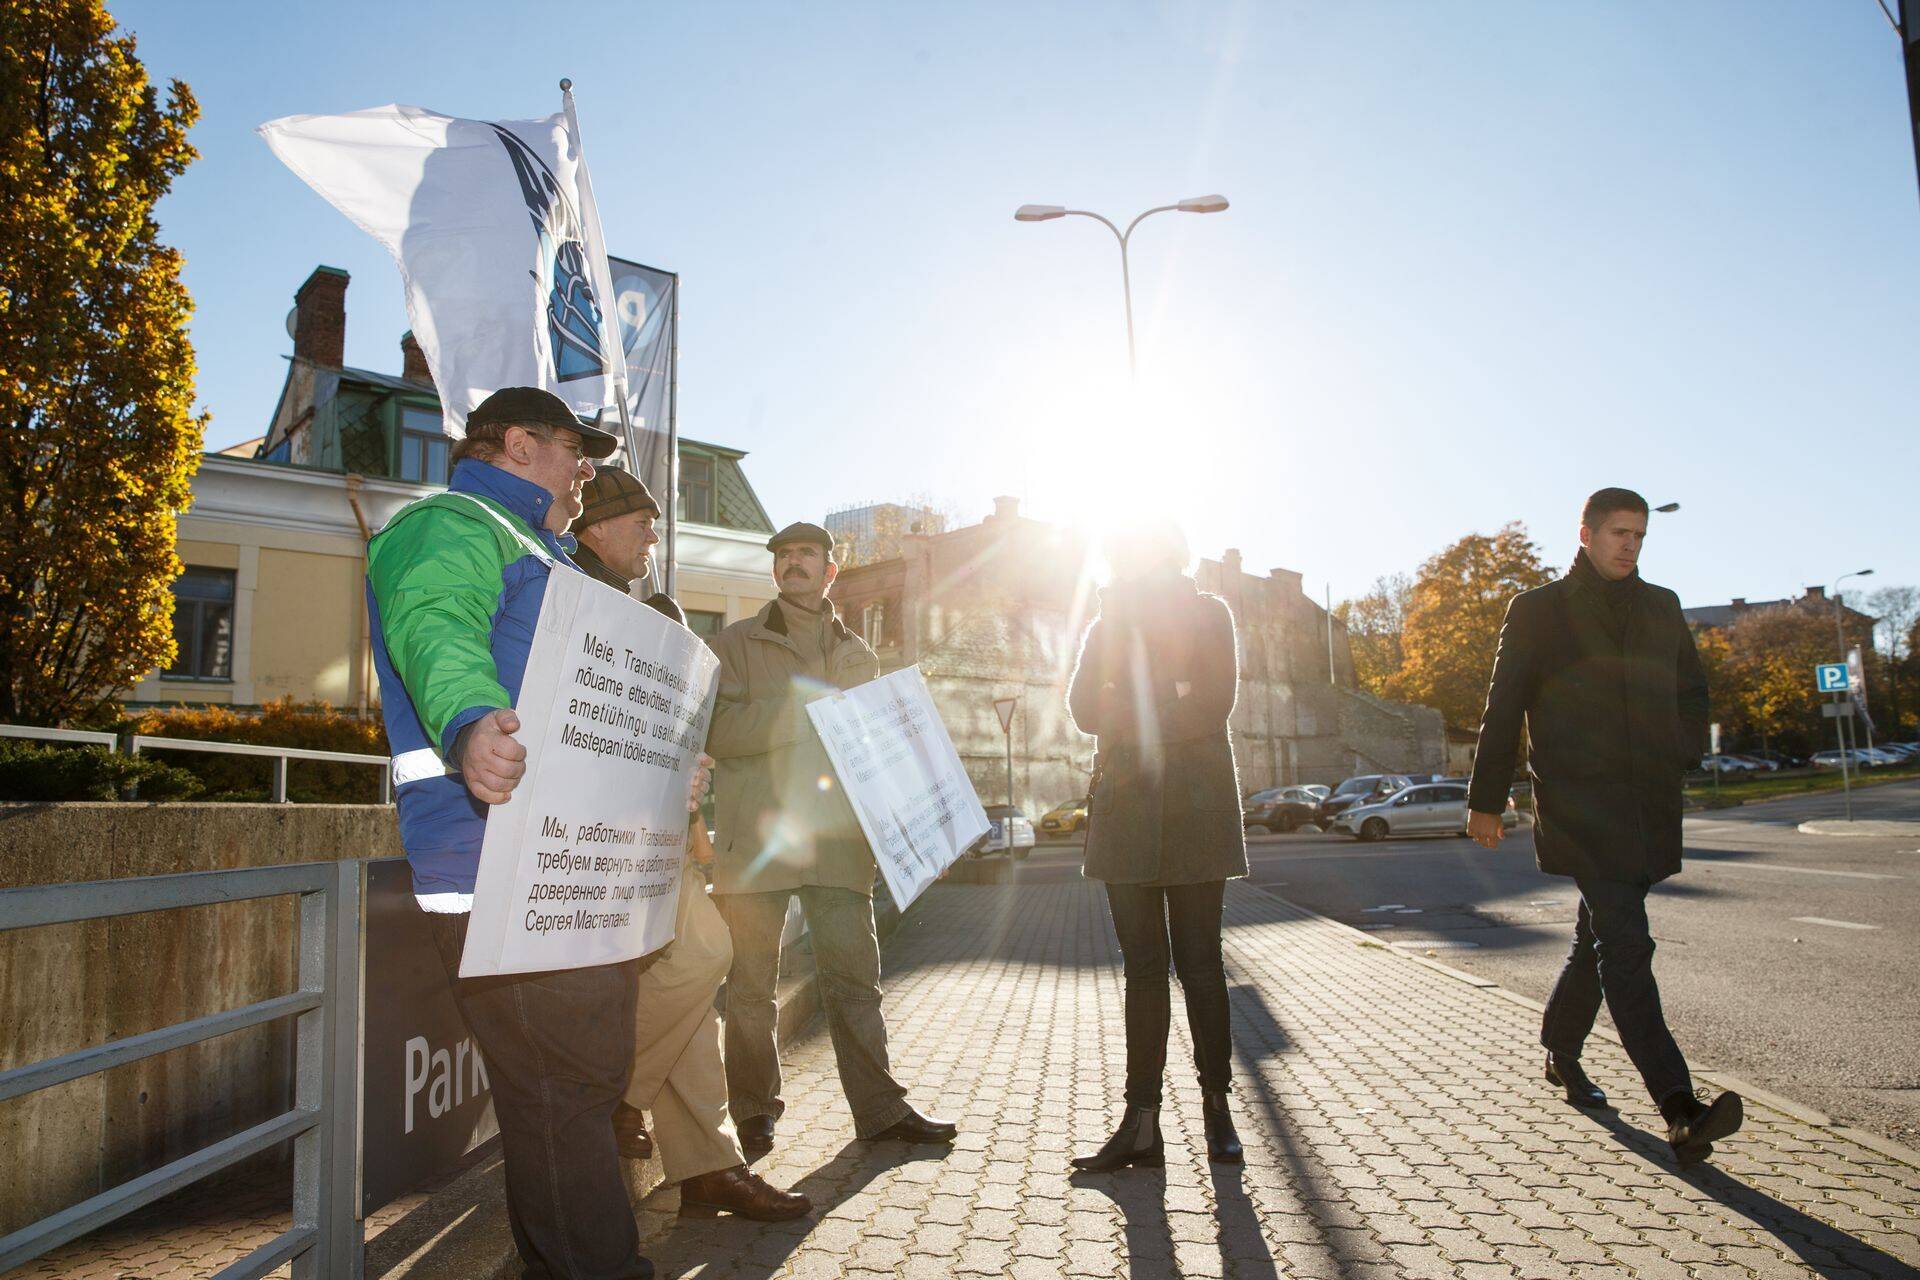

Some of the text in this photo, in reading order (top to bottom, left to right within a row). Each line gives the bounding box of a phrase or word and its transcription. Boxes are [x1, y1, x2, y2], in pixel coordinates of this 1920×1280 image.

[582, 632, 616, 668] Meie,
[575, 666, 623, 697] nõuame
[628, 684, 672, 715] ettevõttest
[1824, 668, 1841, 689] P
[568, 698, 647, 737] ametiühingu
[561, 723, 623, 758] Mastepani
[623, 741, 646, 763] tööle
[541, 815, 569, 843] Мы,
[576, 822, 636, 846] работники
[537, 849, 591, 875] требуем
[594, 856, 633, 877] вернуть
[635, 858, 644, 873] на
[528, 883, 607, 906] доверенное
[611, 884, 635, 903] лицо
[525, 909, 574, 936] Сергея
